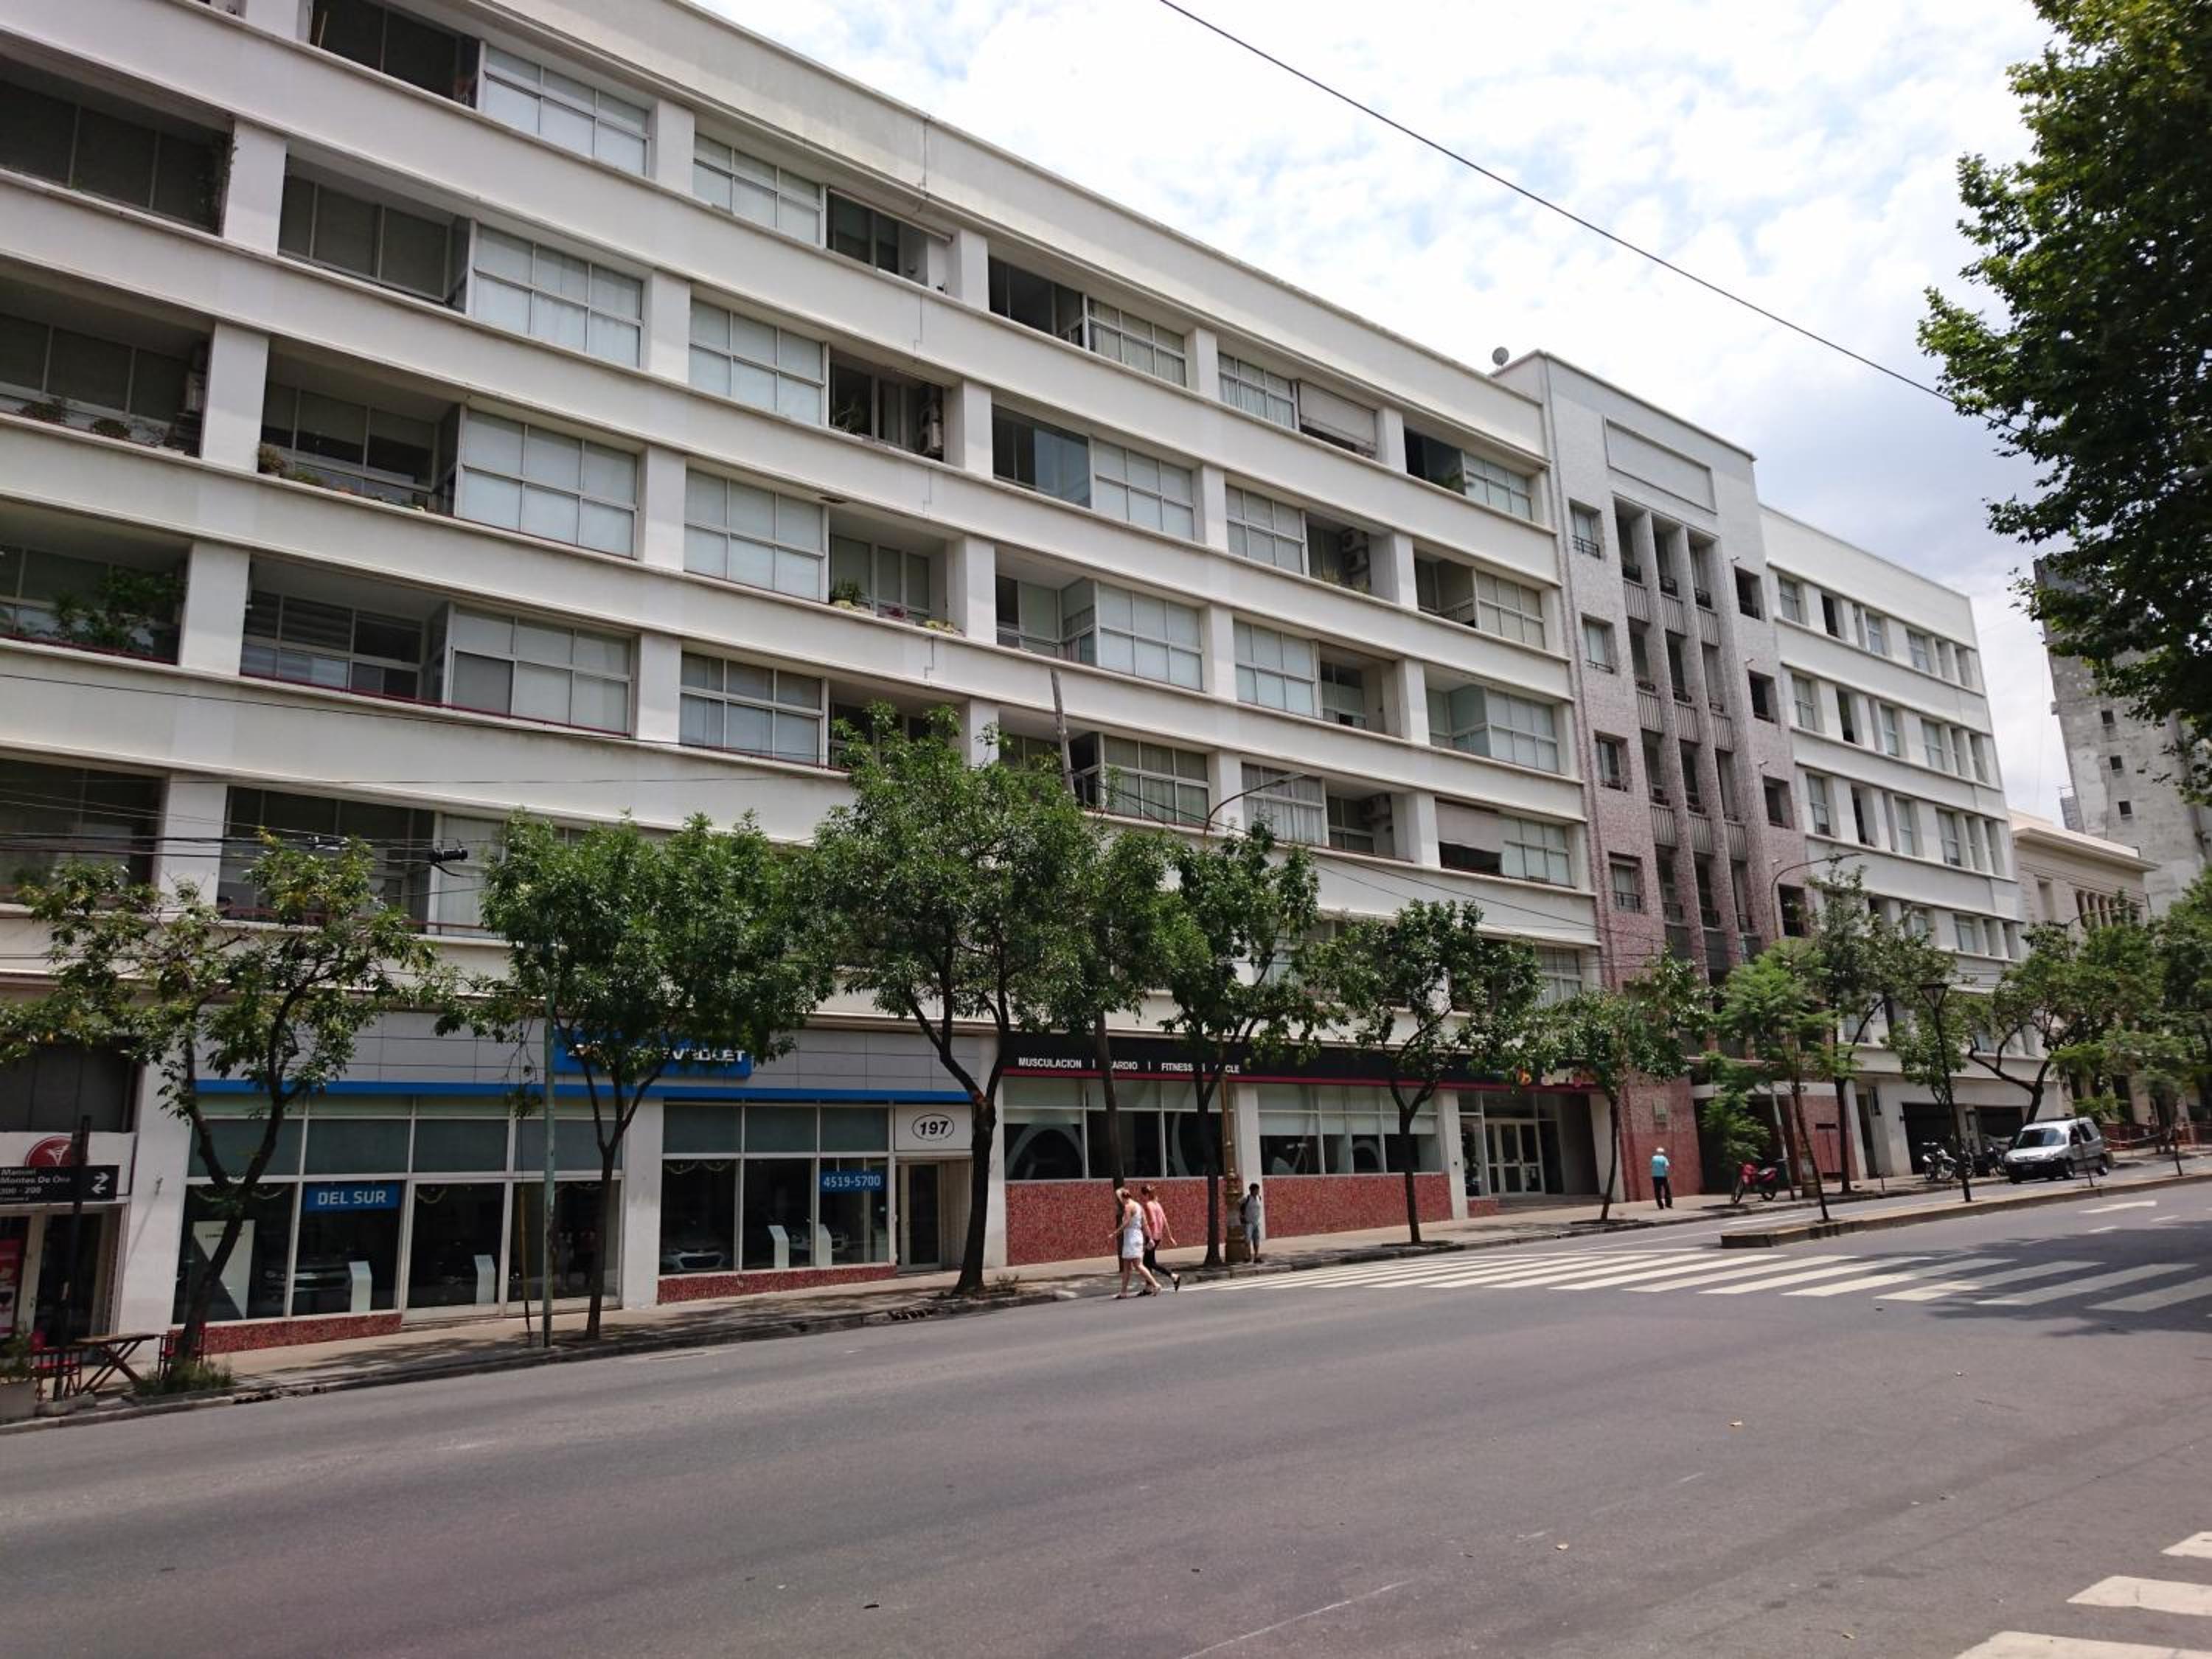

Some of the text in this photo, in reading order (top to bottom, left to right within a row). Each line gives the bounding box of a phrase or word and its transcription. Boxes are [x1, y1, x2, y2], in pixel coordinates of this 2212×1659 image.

[1018, 1057, 1240, 1074] MUSCULACION ARDIO FITNESS CLE
[919, 1120, 949, 1135] 197
[823, 1175, 881, 1189] 4519-5700
[318, 1189, 387, 1206] DEL SUR
